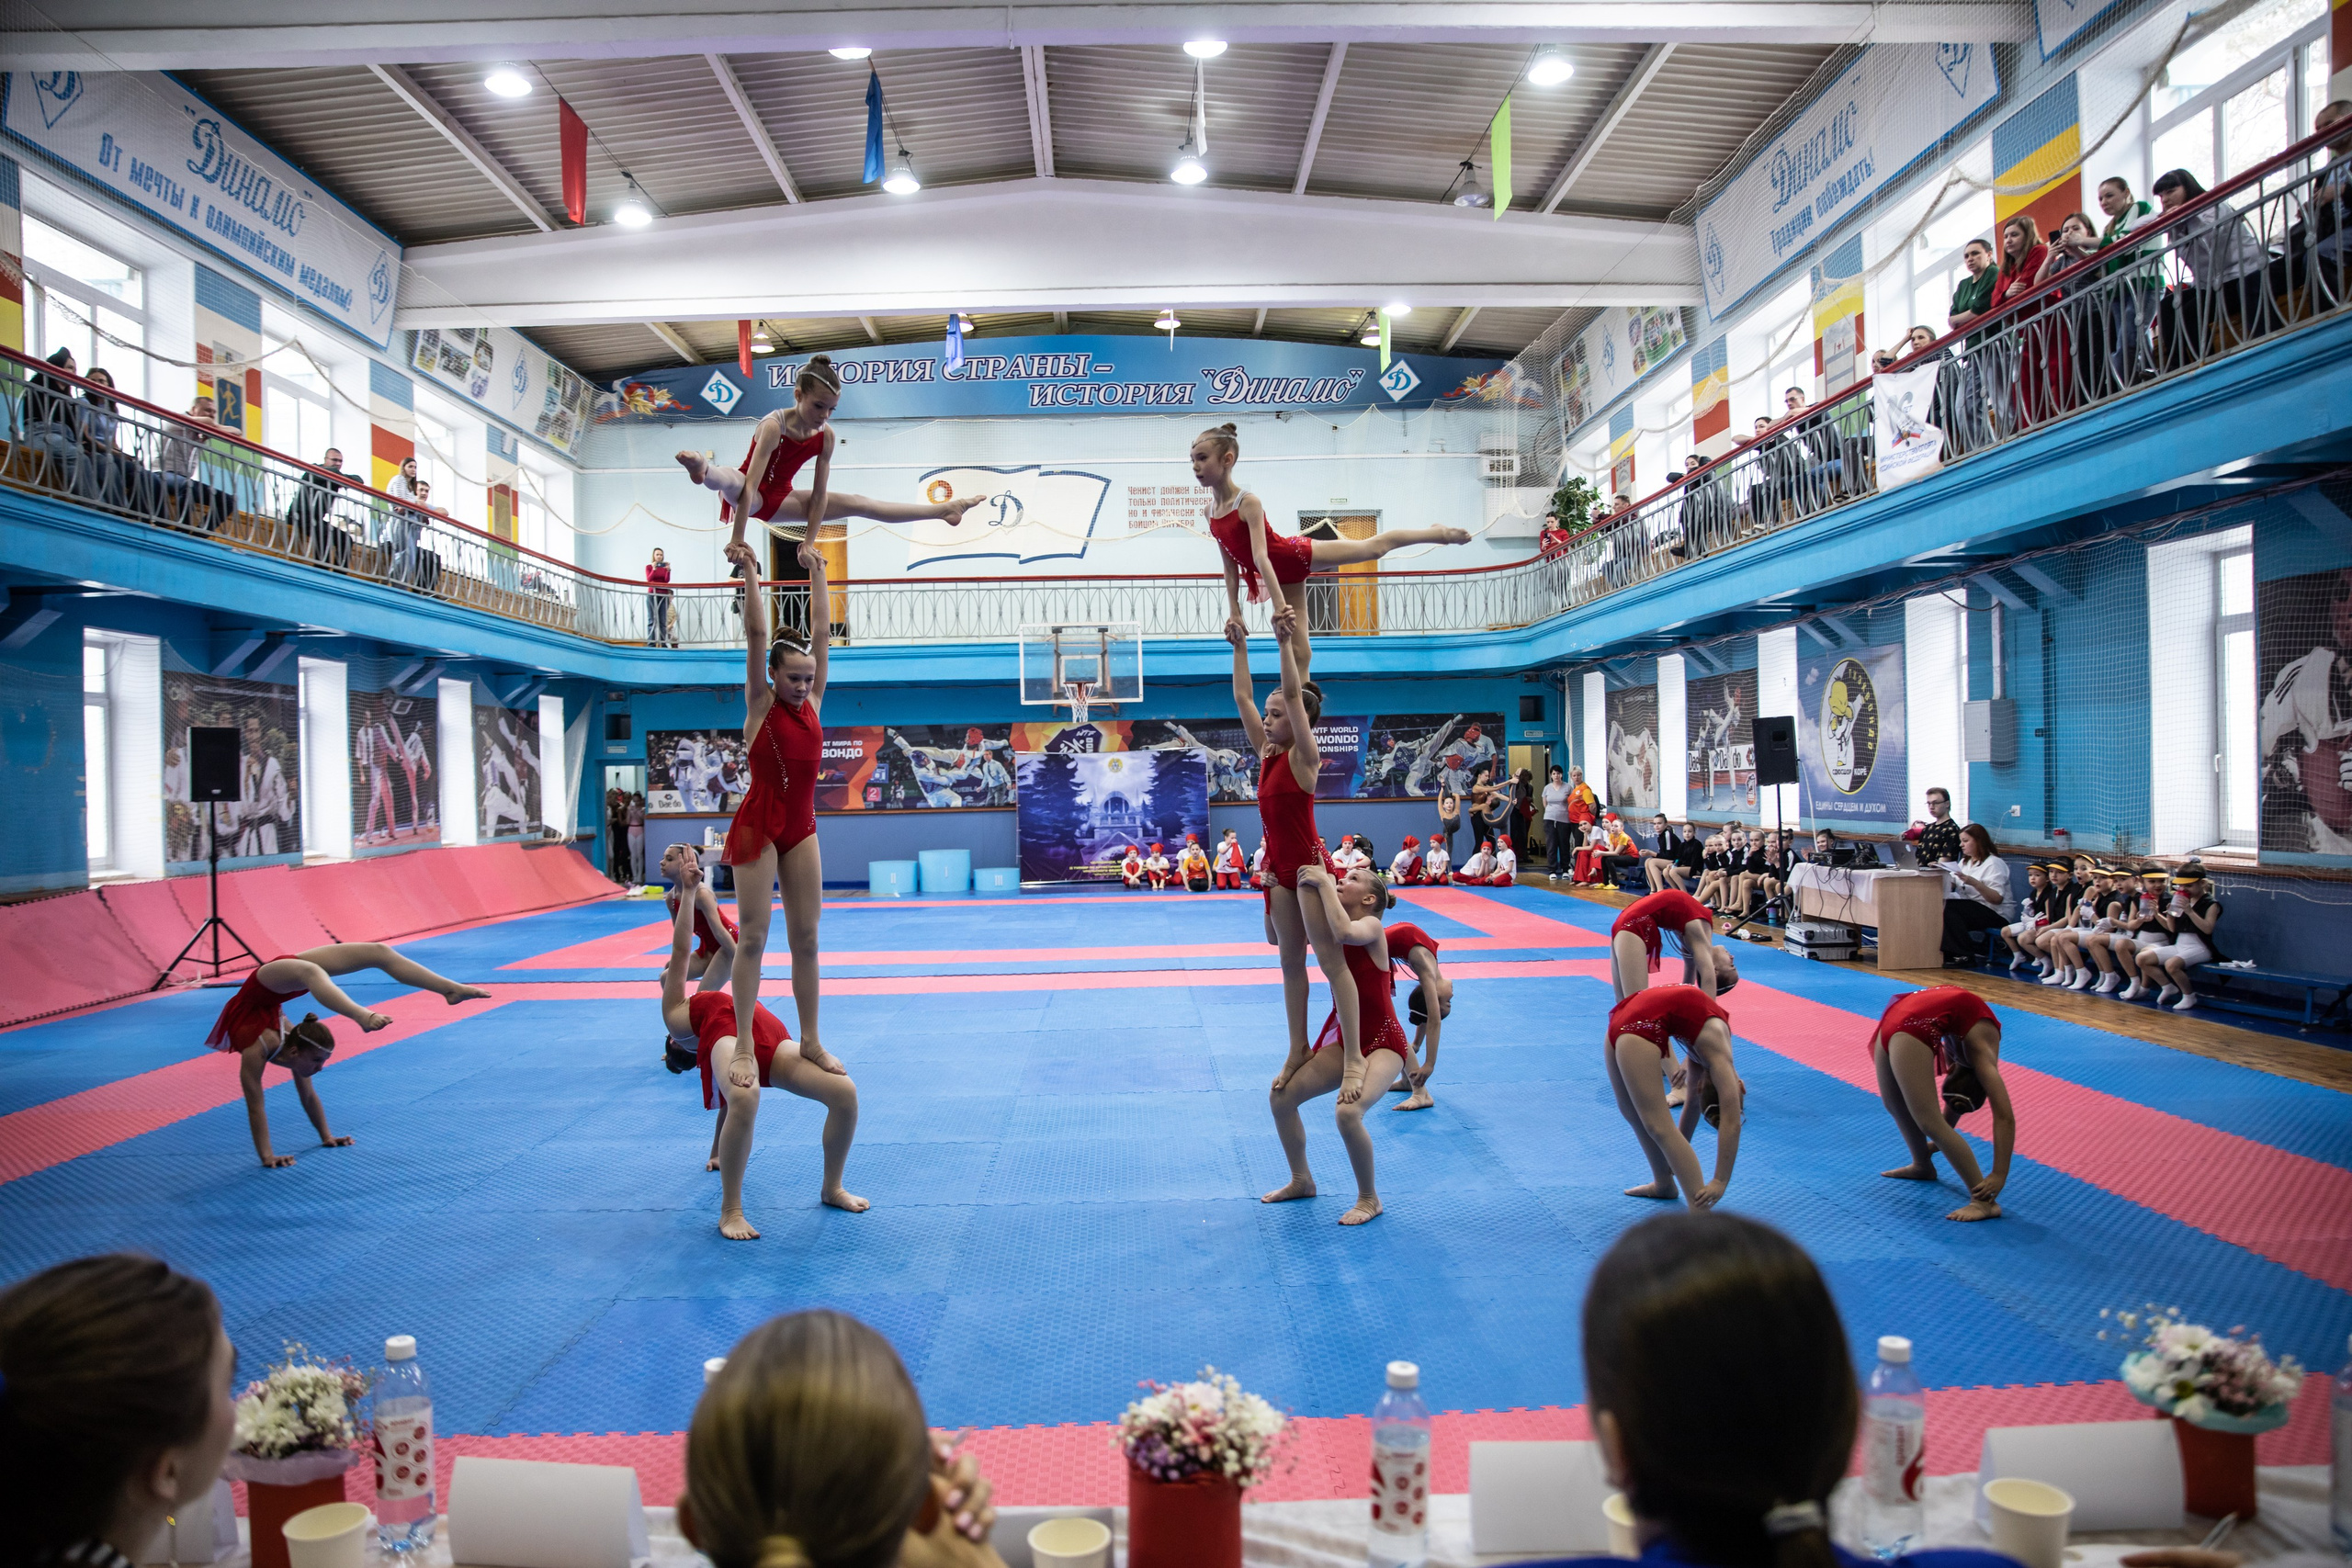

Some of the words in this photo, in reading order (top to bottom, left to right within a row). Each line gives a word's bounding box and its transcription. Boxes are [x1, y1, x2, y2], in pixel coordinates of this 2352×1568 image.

[98, 132, 123, 174] От
[129, 156, 186, 211] мечты
[189, 193, 200, 220] к
[205, 203, 297, 278] олимпийским
[298, 262, 354, 313] медалям!
[768, 358, 936, 388] ИОРИЯ
[942, 353, 1091, 381] СТРАНЫ
[1029, 382, 1197, 407] ИСТОРИЯ
[1201, 365, 1364, 405] "Динамо"
[821, 748, 864, 760] ВОНДО
[869, 787, 877, 798] 2
[1815, 800, 1833, 812] ЕДИНЫ
[1834, 801, 1859, 813] СЕРДЦЕМ
